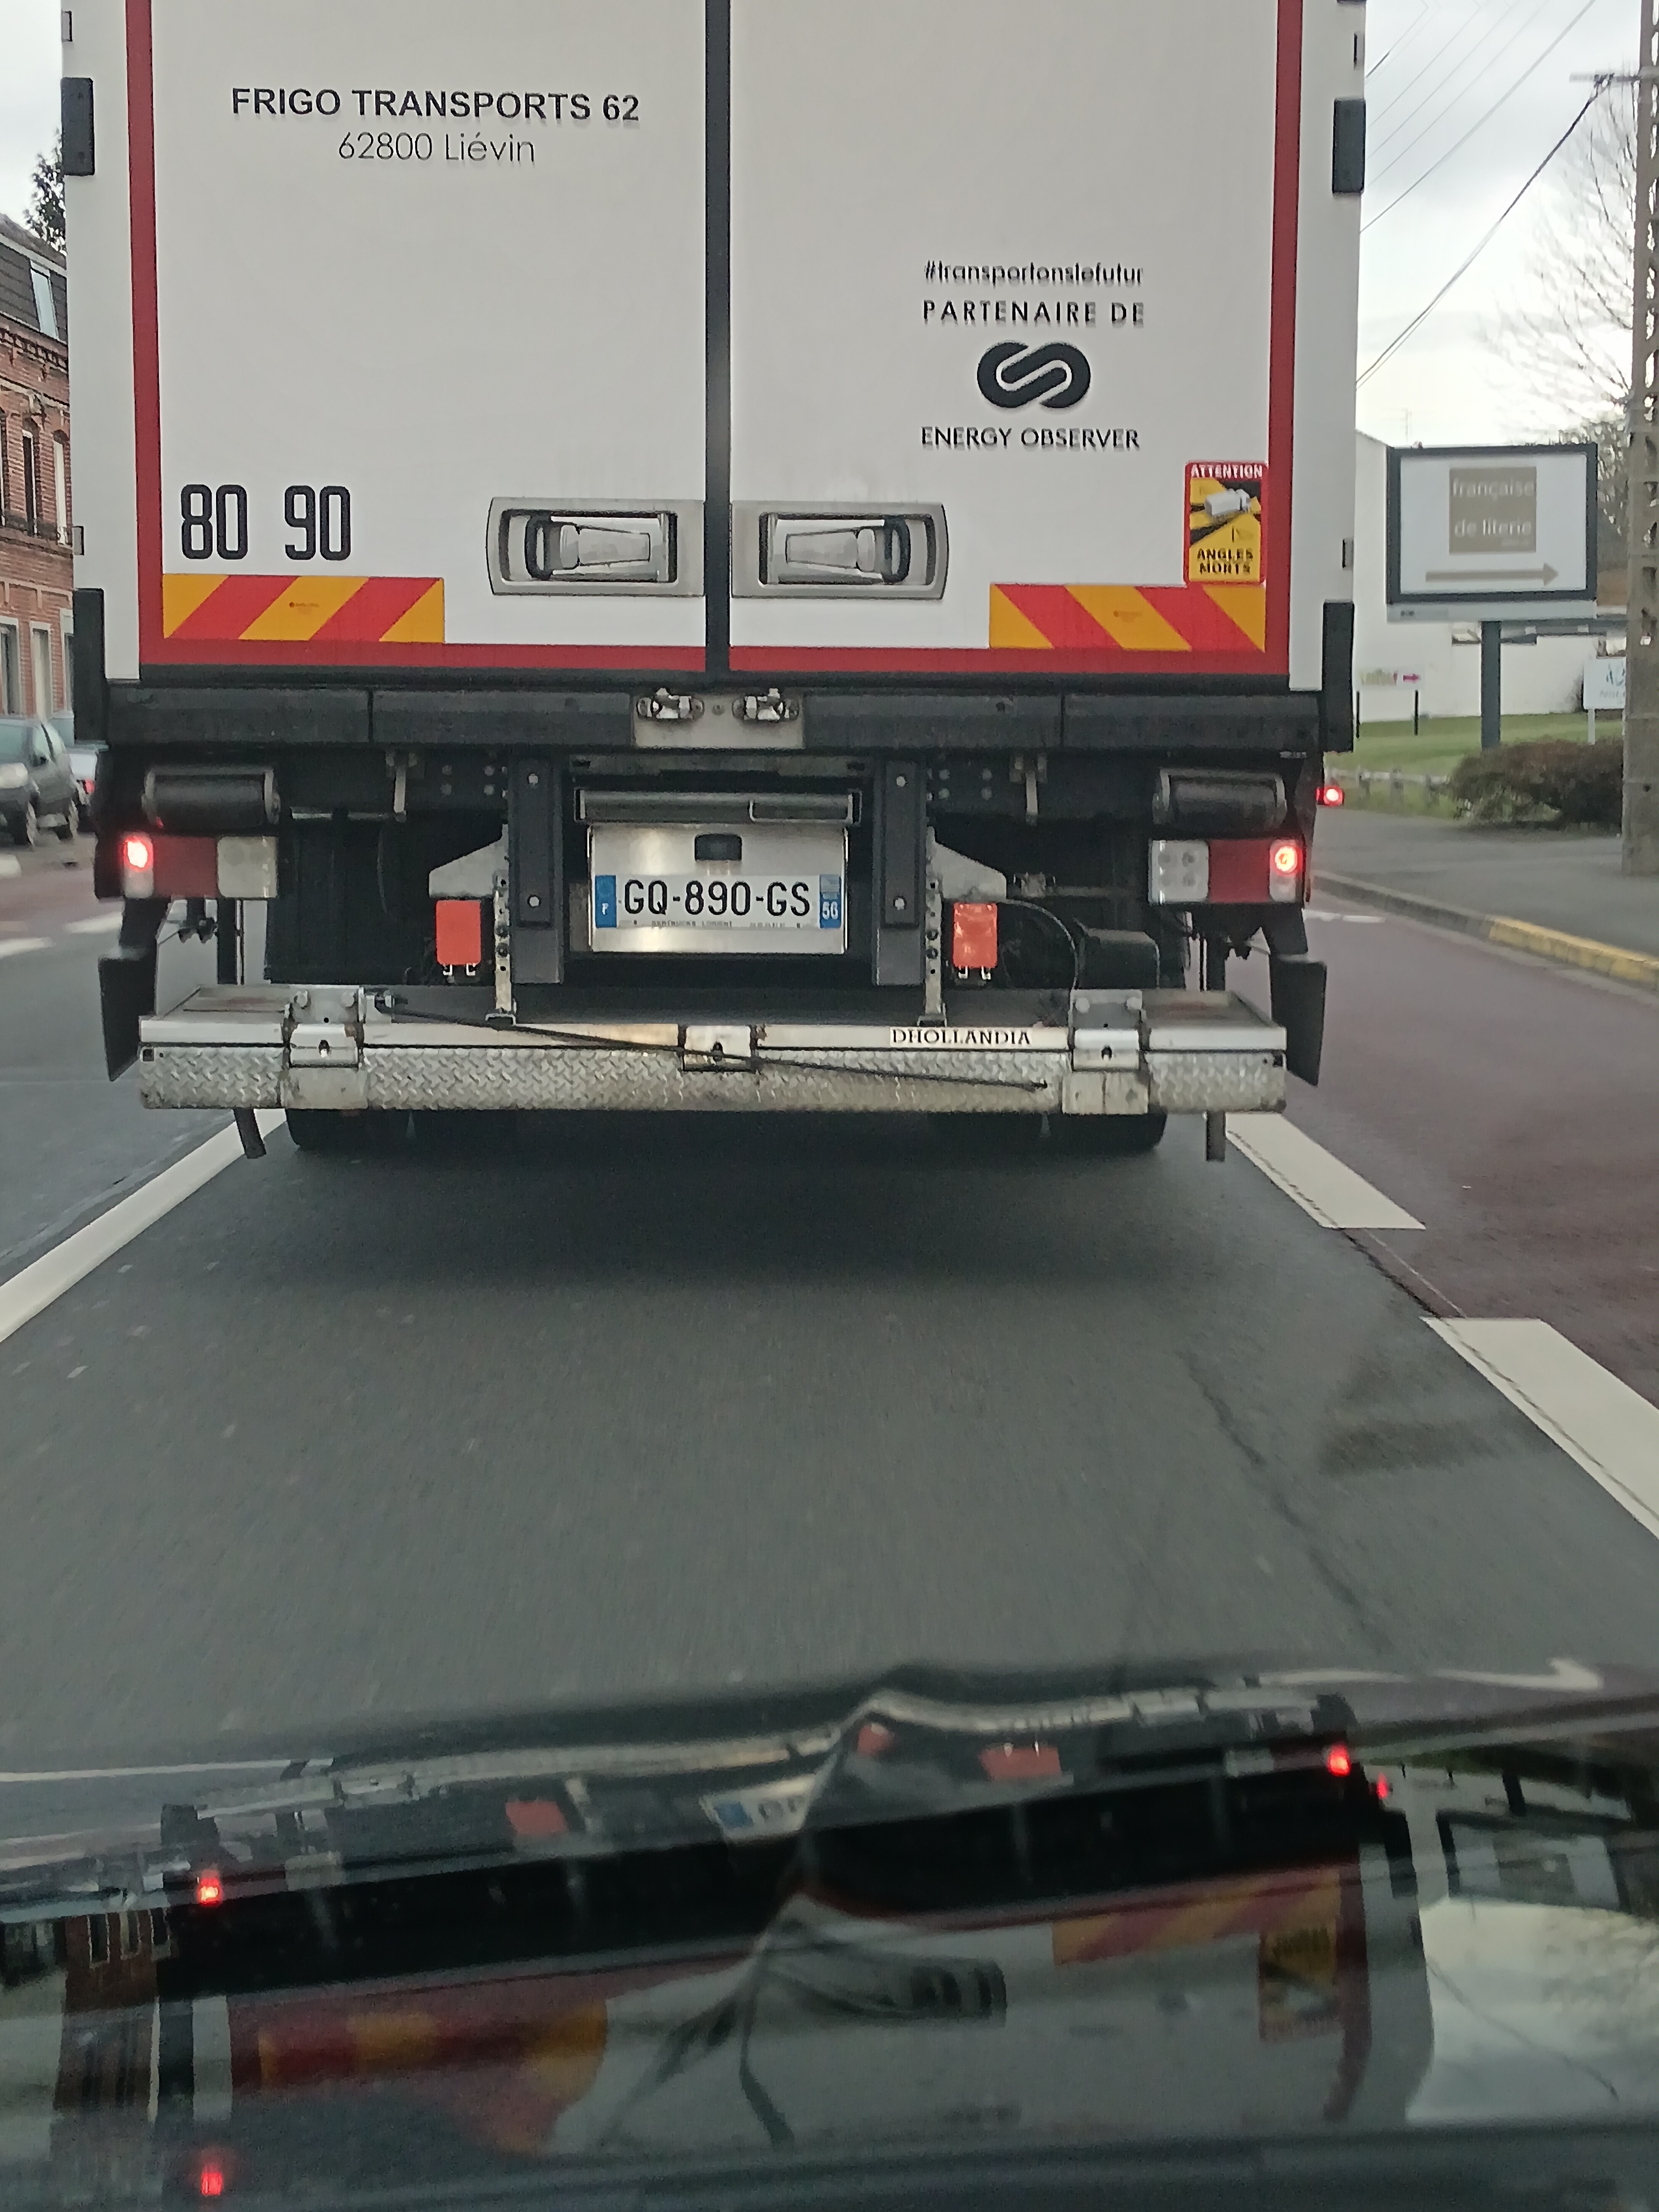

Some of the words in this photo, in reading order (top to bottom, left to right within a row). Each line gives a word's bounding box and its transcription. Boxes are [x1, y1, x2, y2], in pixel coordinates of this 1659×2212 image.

[232, 87, 341, 115] FRIGO
[351, 90, 591, 120] TRANSPORTS
[603, 94, 639, 121] 62
[338, 132, 432, 160] 62800
[445, 133, 535, 162] Liévin
[923, 300, 1095, 324] PARTENAIRE
[1111, 302, 1143, 325] DE
[921, 426, 1011, 449] ENERGY
[1021, 427, 1140, 449] OBSERVER
[1191, 464, 1262, 478] ATTENTION
[181, 484, 247, 559] 80
[285, 485, 351, 561] 90
[1197, 548, 1253, 561] ANGLES
[1199, 562, 1250, 575] MORTS
[624, 880, 810, 917] GQ-890-GS
[892, 1029, 1030, 1045] DHOLLANDIA
